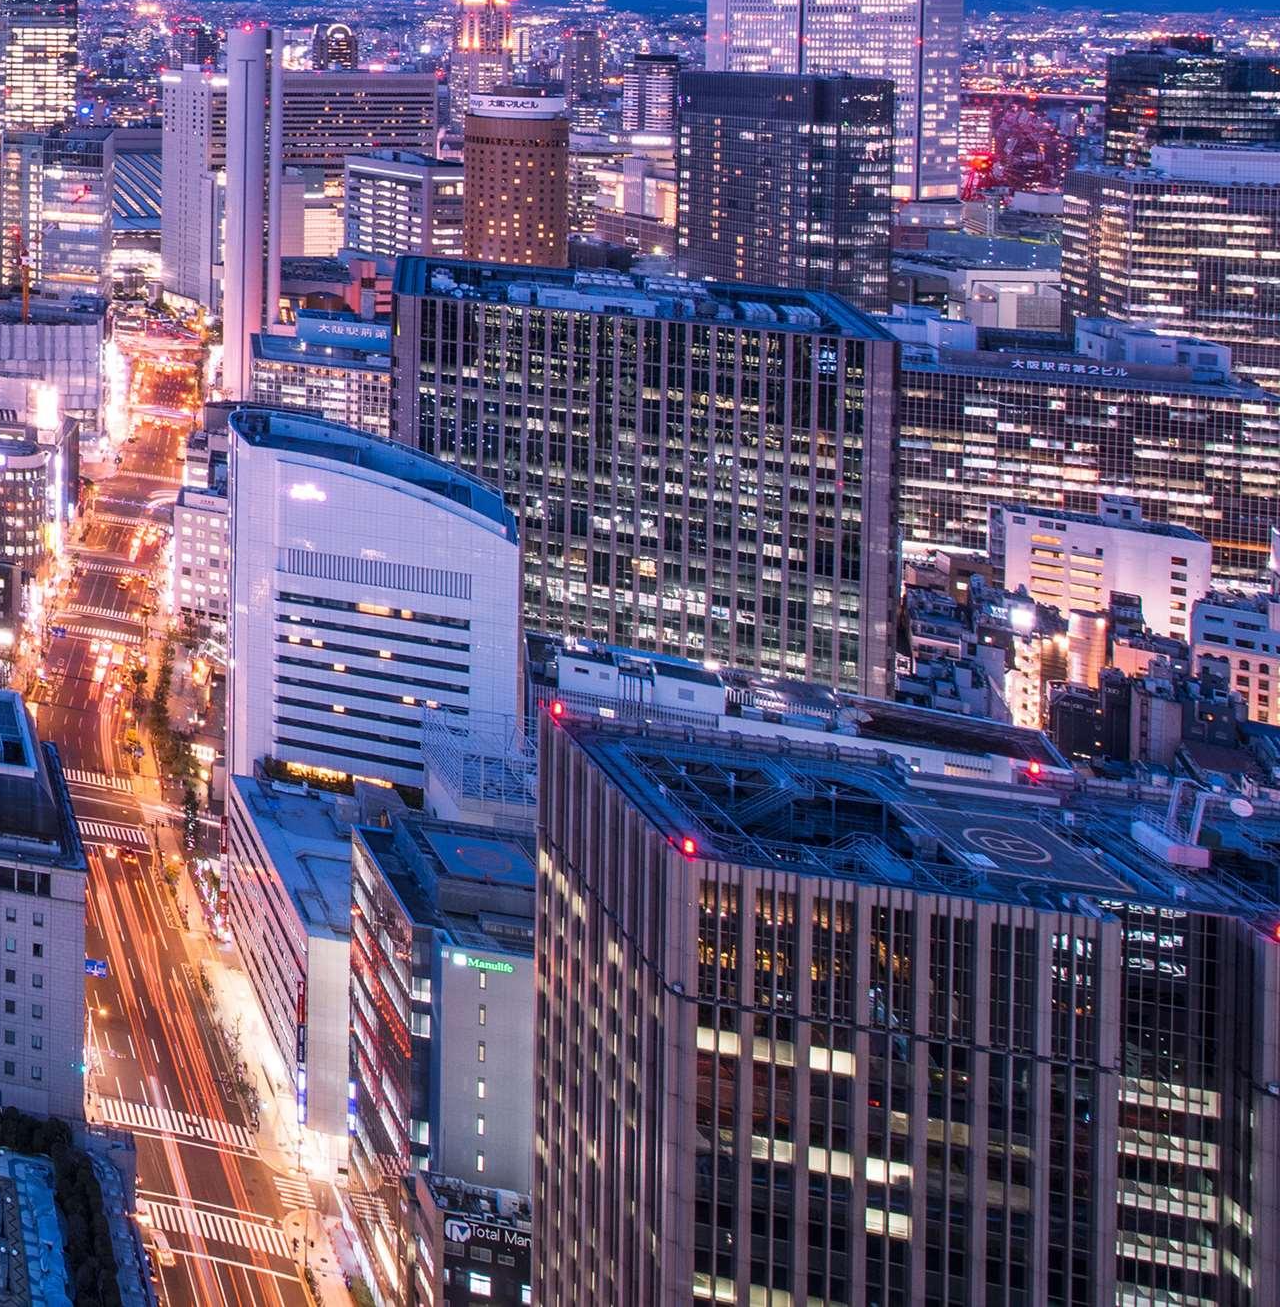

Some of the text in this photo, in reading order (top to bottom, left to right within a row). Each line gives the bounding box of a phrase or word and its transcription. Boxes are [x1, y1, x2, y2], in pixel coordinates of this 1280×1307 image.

[1011, 358, 1128, 377] 大阪駅前第2ビル
[467, 957, 514, 973] Manulife
[469, 1222, 501, 1242] Total
